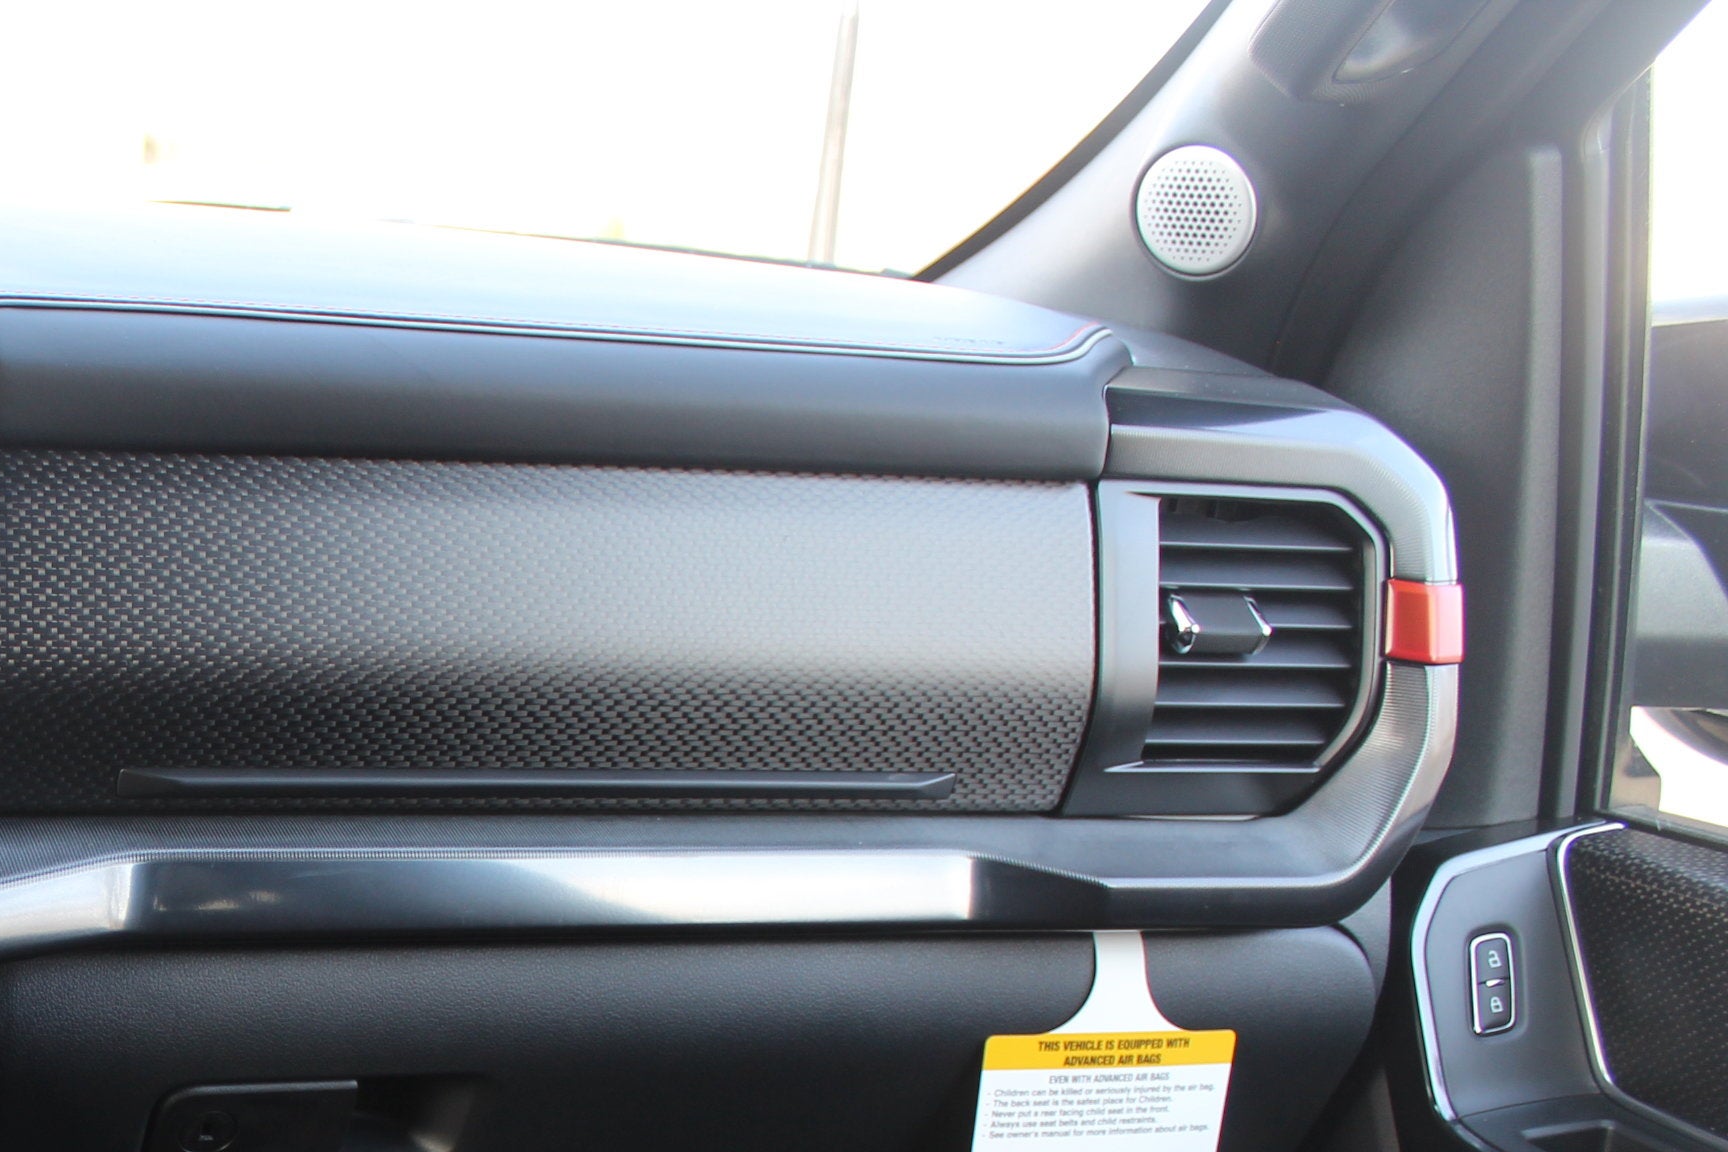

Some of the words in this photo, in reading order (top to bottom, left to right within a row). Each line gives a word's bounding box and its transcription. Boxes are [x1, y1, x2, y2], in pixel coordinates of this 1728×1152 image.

[1038, 1041, 1060, 1051] THIS
[1064, 1040, 1102, 1051] VEHICLE
[1105, 1040, 1114, 1050] IS
[1118, 1038, 1163, 1050] EQUIPPED
[1166, 1038, 1190, 1048] WITH
[1064, 1056, 1114, 1066] ADVANCED
[1117, 1055, 1134, 1065] AIR
[1137, 1054, 1161, 1064] BAGS
[1049, 1076, 1069, 1084] EVEN
[1072, 1075, 1092, 1083] WITH
[1094, 1074, 1133, 1083] ADVANCED
[1135, 1073, 1148, 1081] AIR
[1150, 1072, 1170, 1080] BAGS
[994, 1089, 1030, 1097] Children
[1049, 1088, 1058, 1096] be
[1096, 1086, 1131, 1096] seriously
[1134, 1086, 1160, 1096] injured
[994, 1100, 1008, 1108] The
[1077, 1097, 1100, 1105] safest
[1103, 1096, 1123, 1106] place
[991, 1109, 1015, 1118] Never
[1060, 1108, 1083, 1118] facing
[990, 1120, 1020, 1129] Always
[1098, 1117, 1117, 1125] child
[989, 1131, 1004, 1139] See
[1042, 1129, 1070, 1137] manual
[1073, 1128, 1084, 1136] for
[1109, 1126, 1152, 1135] information
[1155, 1124, 1176, 1132] about
